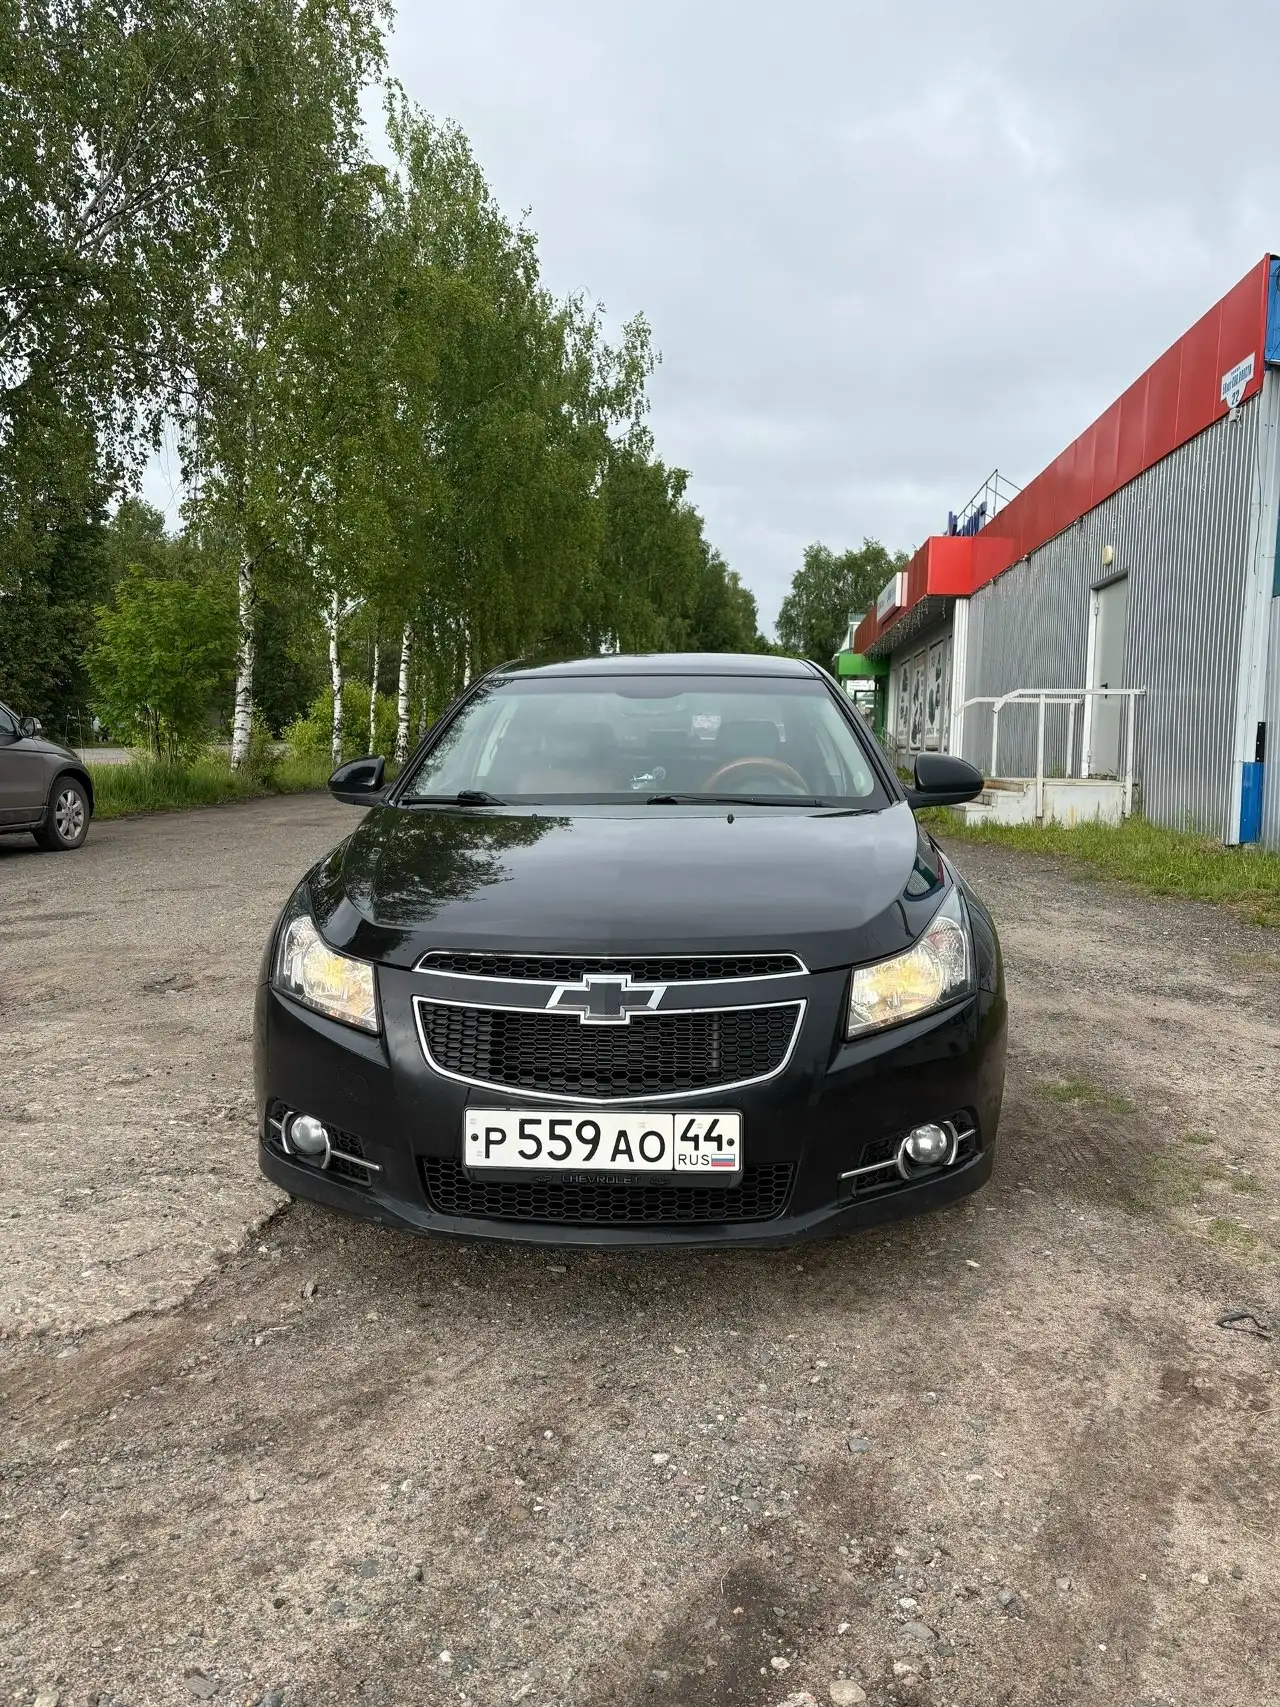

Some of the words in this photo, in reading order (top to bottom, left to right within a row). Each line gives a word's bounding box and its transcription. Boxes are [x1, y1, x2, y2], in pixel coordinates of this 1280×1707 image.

[1231, 389, 1240, 405] 22
[517, 1118, 601, 1162] 559
[680, 1118, 724, 1152] 44
[677, 1154, 710, 1167] RUS
[562, 1174, 641, 1185] CHEVROLET
